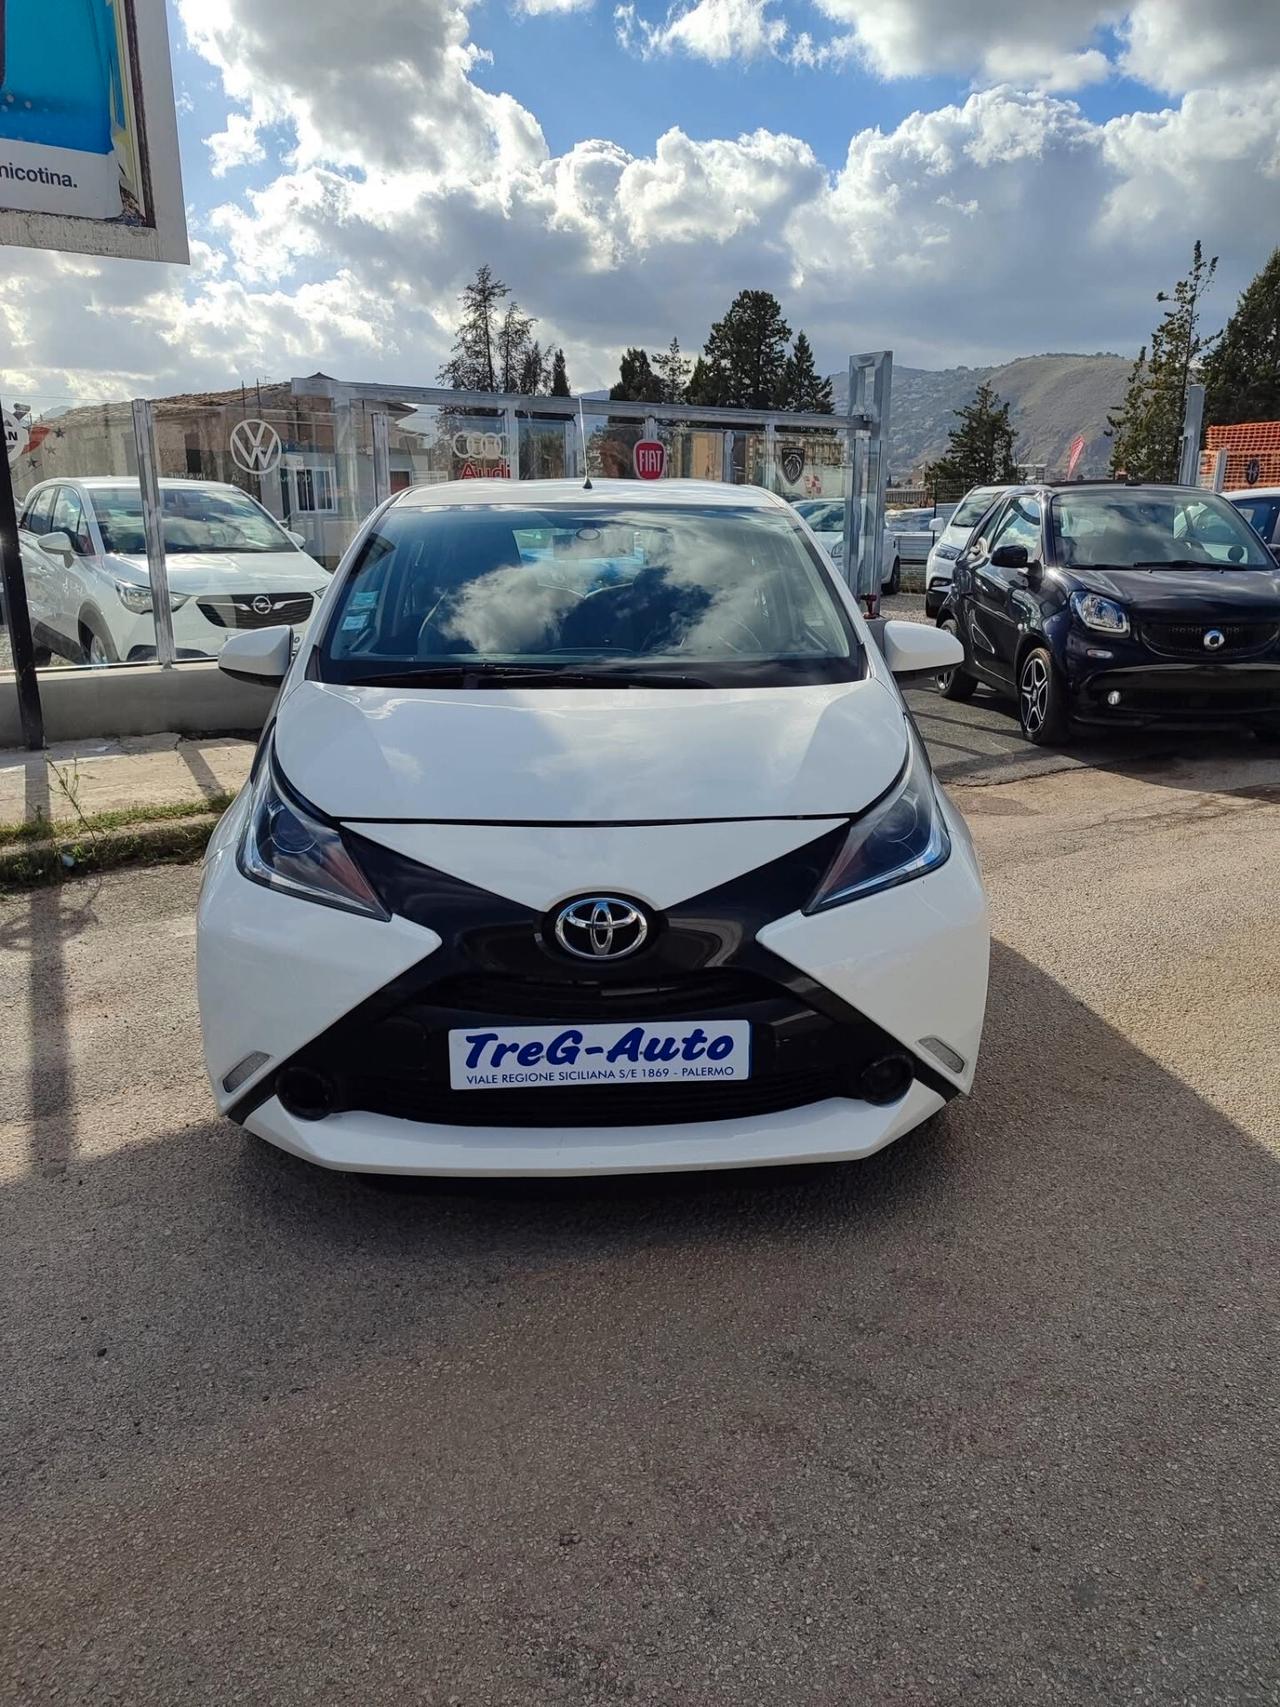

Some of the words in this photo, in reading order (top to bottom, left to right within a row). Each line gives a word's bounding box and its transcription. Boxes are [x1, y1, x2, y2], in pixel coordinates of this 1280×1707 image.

[0, 162, 78, 188] nicotina.
[461, 459, 511, 479] Audi
[639, 449, 662, 472] FIAT
[465, 1027, 734, 1069] TreG-Auto
[466, 1074, 498, 1085] VIALE
[502, 1072, 554, 1083] REGIONE
[558, 1069, 616, 1081] SICILIANA
[619, 1069, 637, 1079] S/E
[642, 1067, 670, 1078] 1869
[682, 1066, 734, 1077] PALERMO
